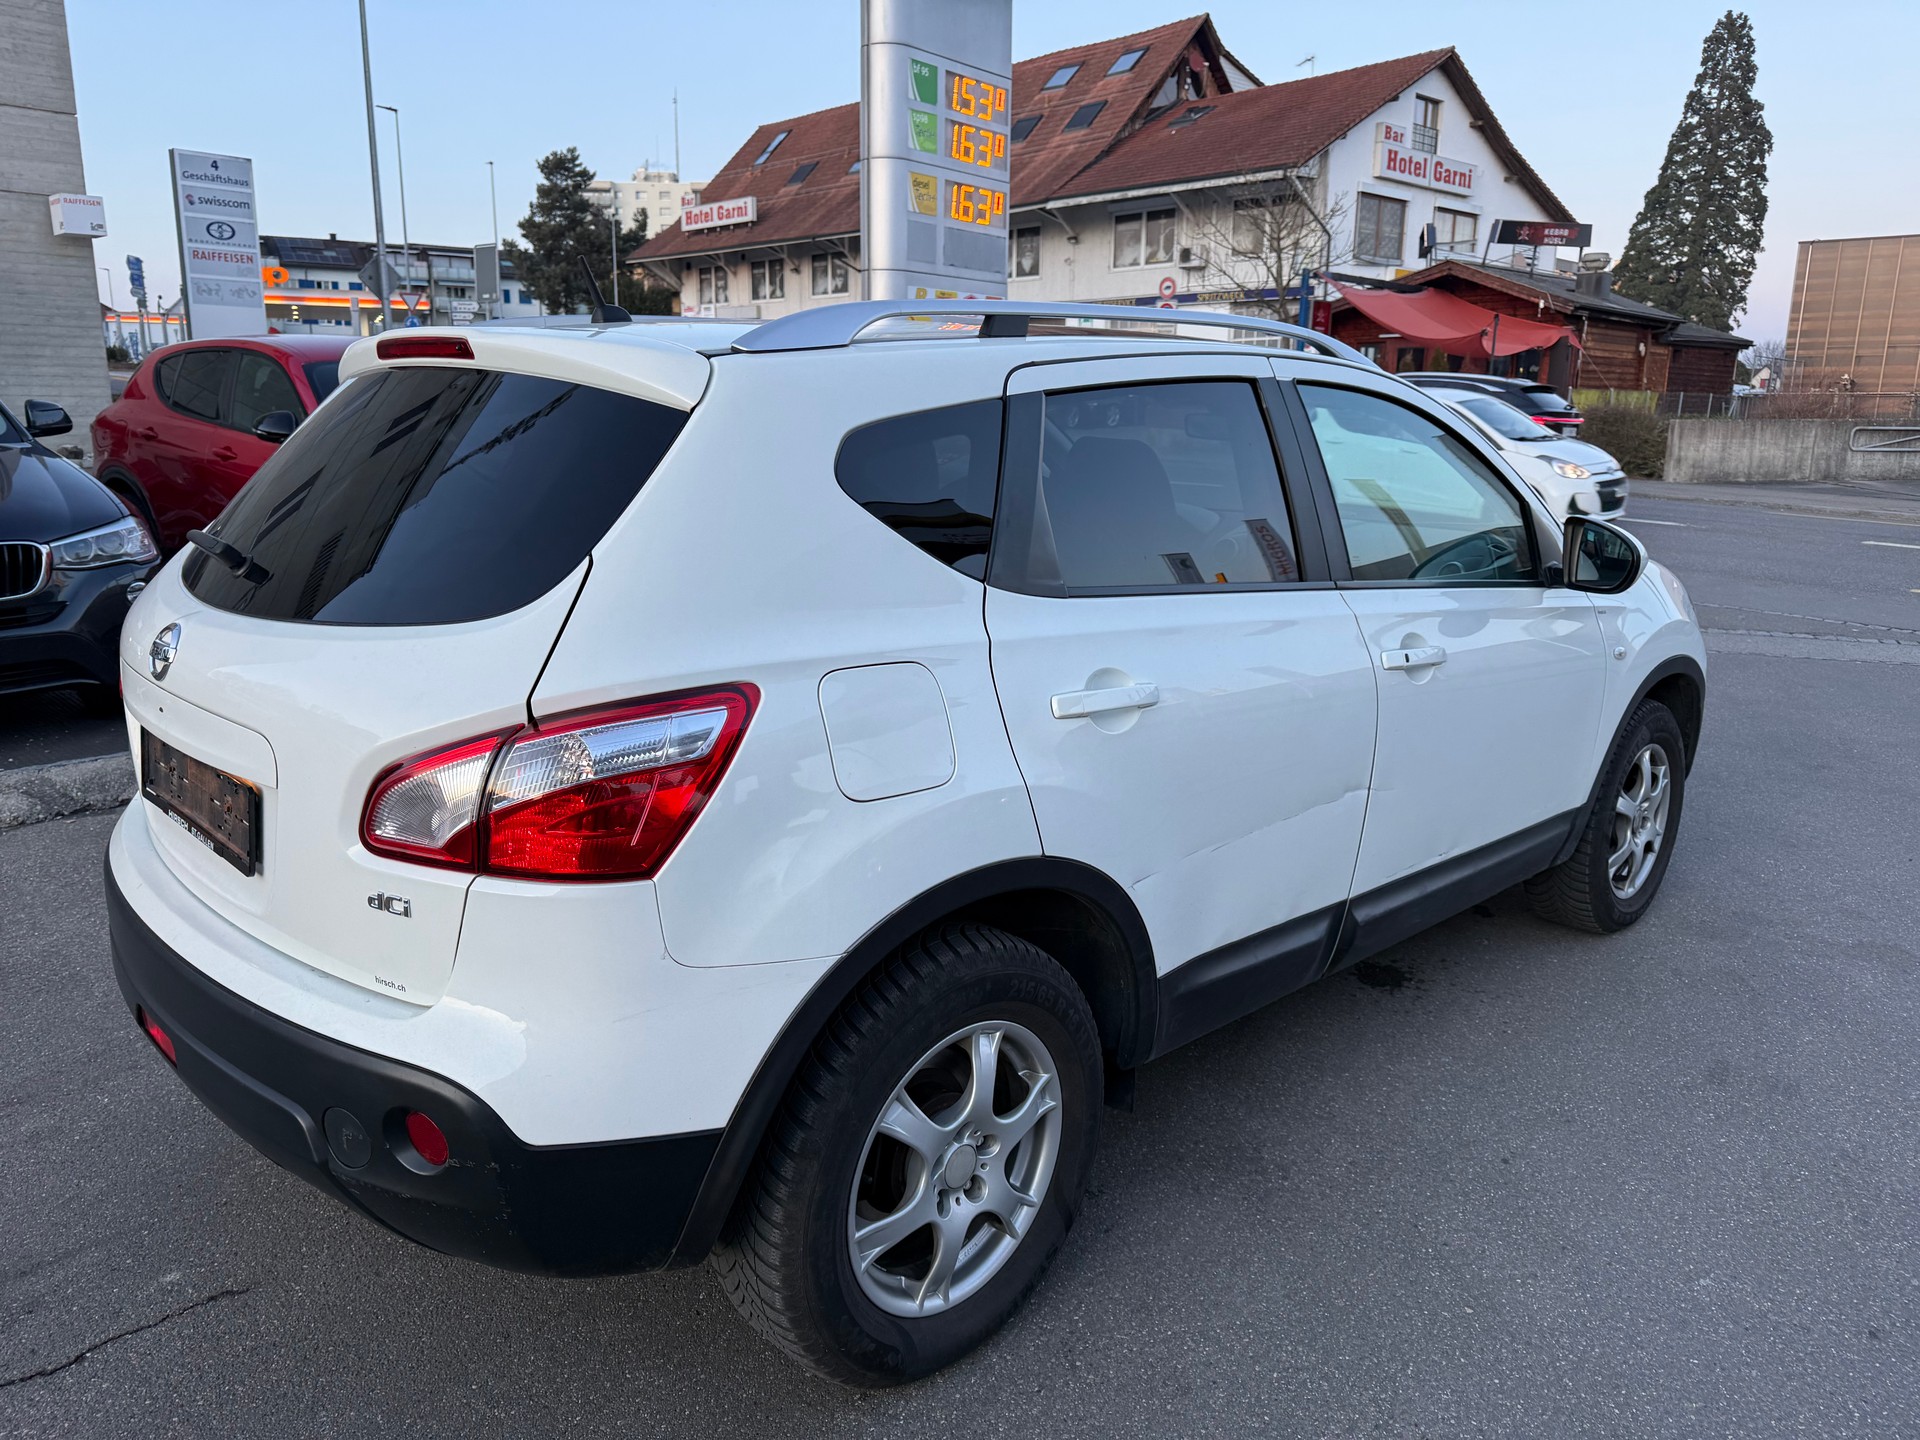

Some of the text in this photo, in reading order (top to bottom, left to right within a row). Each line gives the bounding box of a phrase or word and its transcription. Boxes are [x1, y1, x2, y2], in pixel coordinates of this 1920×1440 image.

[1384, 124, 1405, 143] Bar
[210, 160, 219, 171] 4
[1386, 148, 1473, 189] Hotel Garni
[182, 170, 249, 187] Geschäftshaus
[63, 197, 101, 206] RAIFFEISEN
[197, 195, 251, 210] swisscom
[681, 196, 694, 207] Bar
[685, 201, 748, 226] Hotel Garni
[1543, 227, 1569, 236] KEBAB
[192, 249, 254, 264] RAIFFEISEN
[374, 975, 406, 992] hirsch.ch
